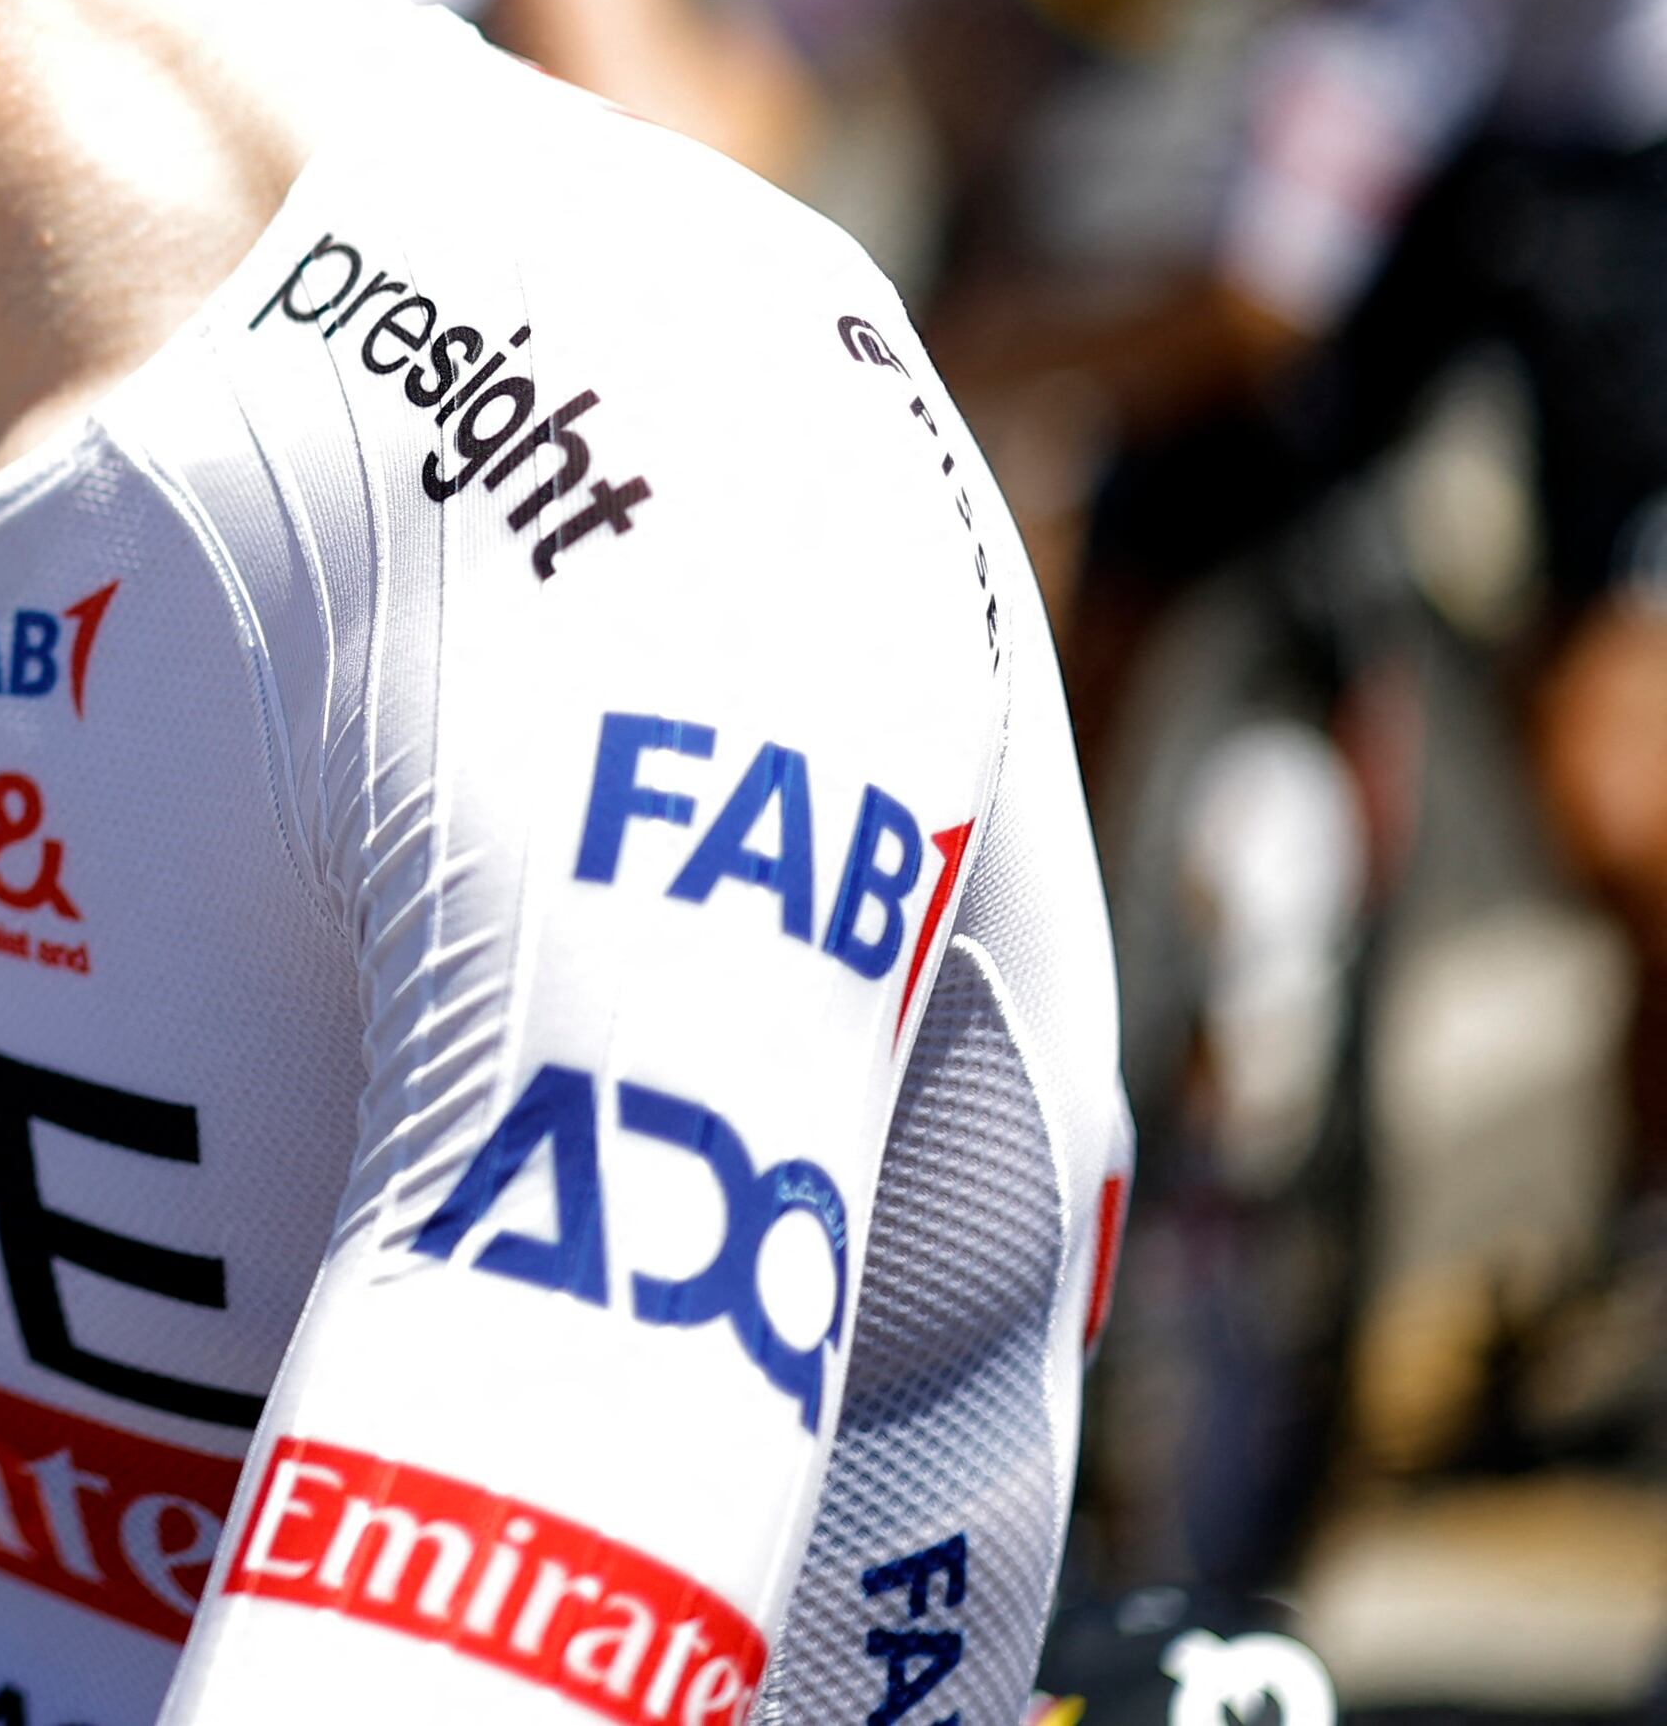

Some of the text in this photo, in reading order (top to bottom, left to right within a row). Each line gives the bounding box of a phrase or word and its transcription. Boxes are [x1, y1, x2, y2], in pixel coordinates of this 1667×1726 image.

[247, 232, 653, 582] presight
[573, 711, 975, 1062] FAB1
[409, 1062, 849, 1437] ADQ
[862, 1531, 968, 1726] FA
